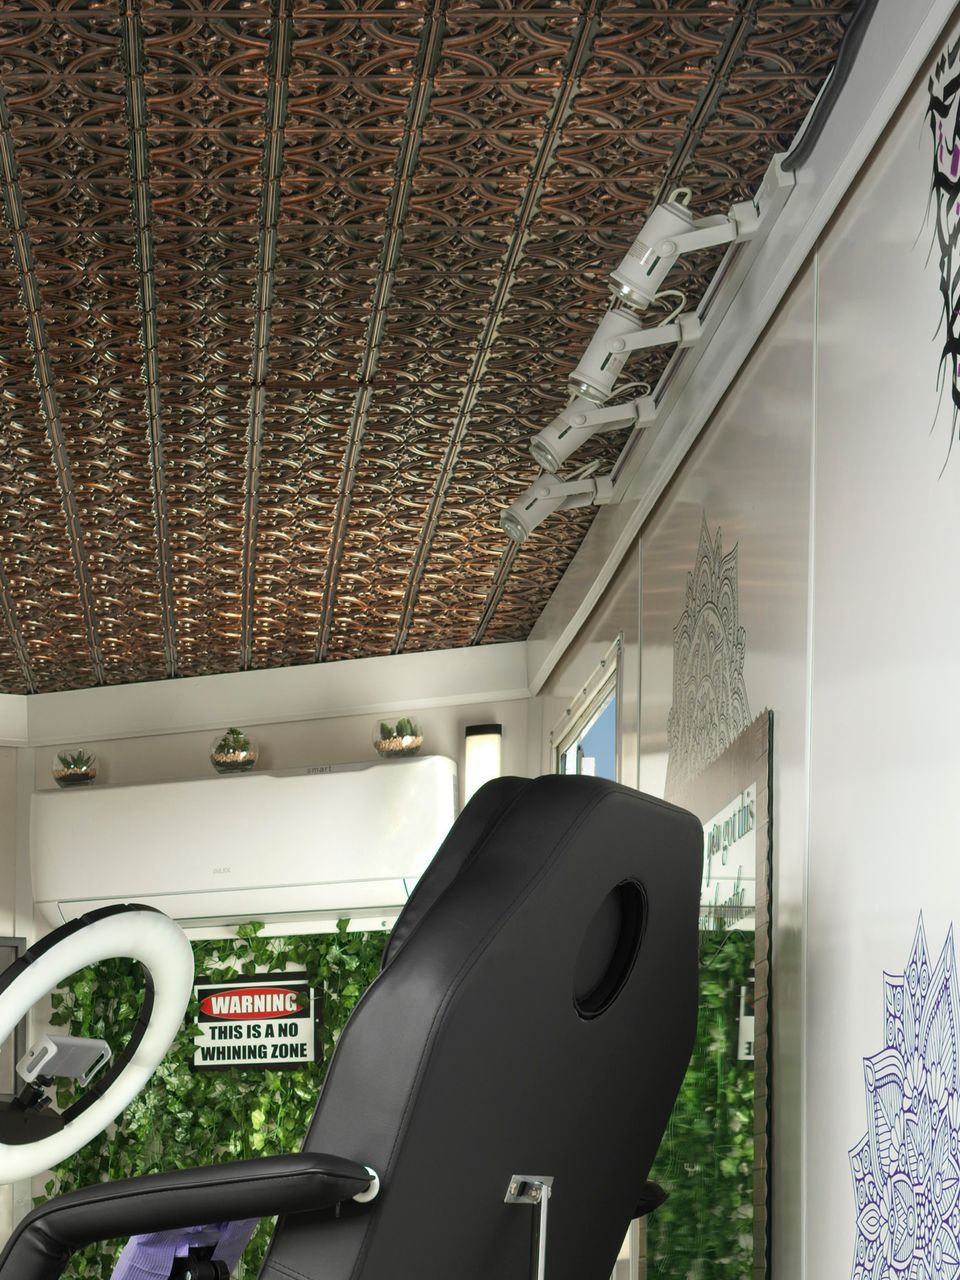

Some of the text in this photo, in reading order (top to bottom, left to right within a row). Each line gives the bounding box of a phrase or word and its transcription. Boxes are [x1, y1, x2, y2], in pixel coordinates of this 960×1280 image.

[211, 993, 297, 1015] WARNING
[209, 1022, 299, 1040] THIS IS A NO
[200, 1042, 307, 1061] WHINING ZONE
